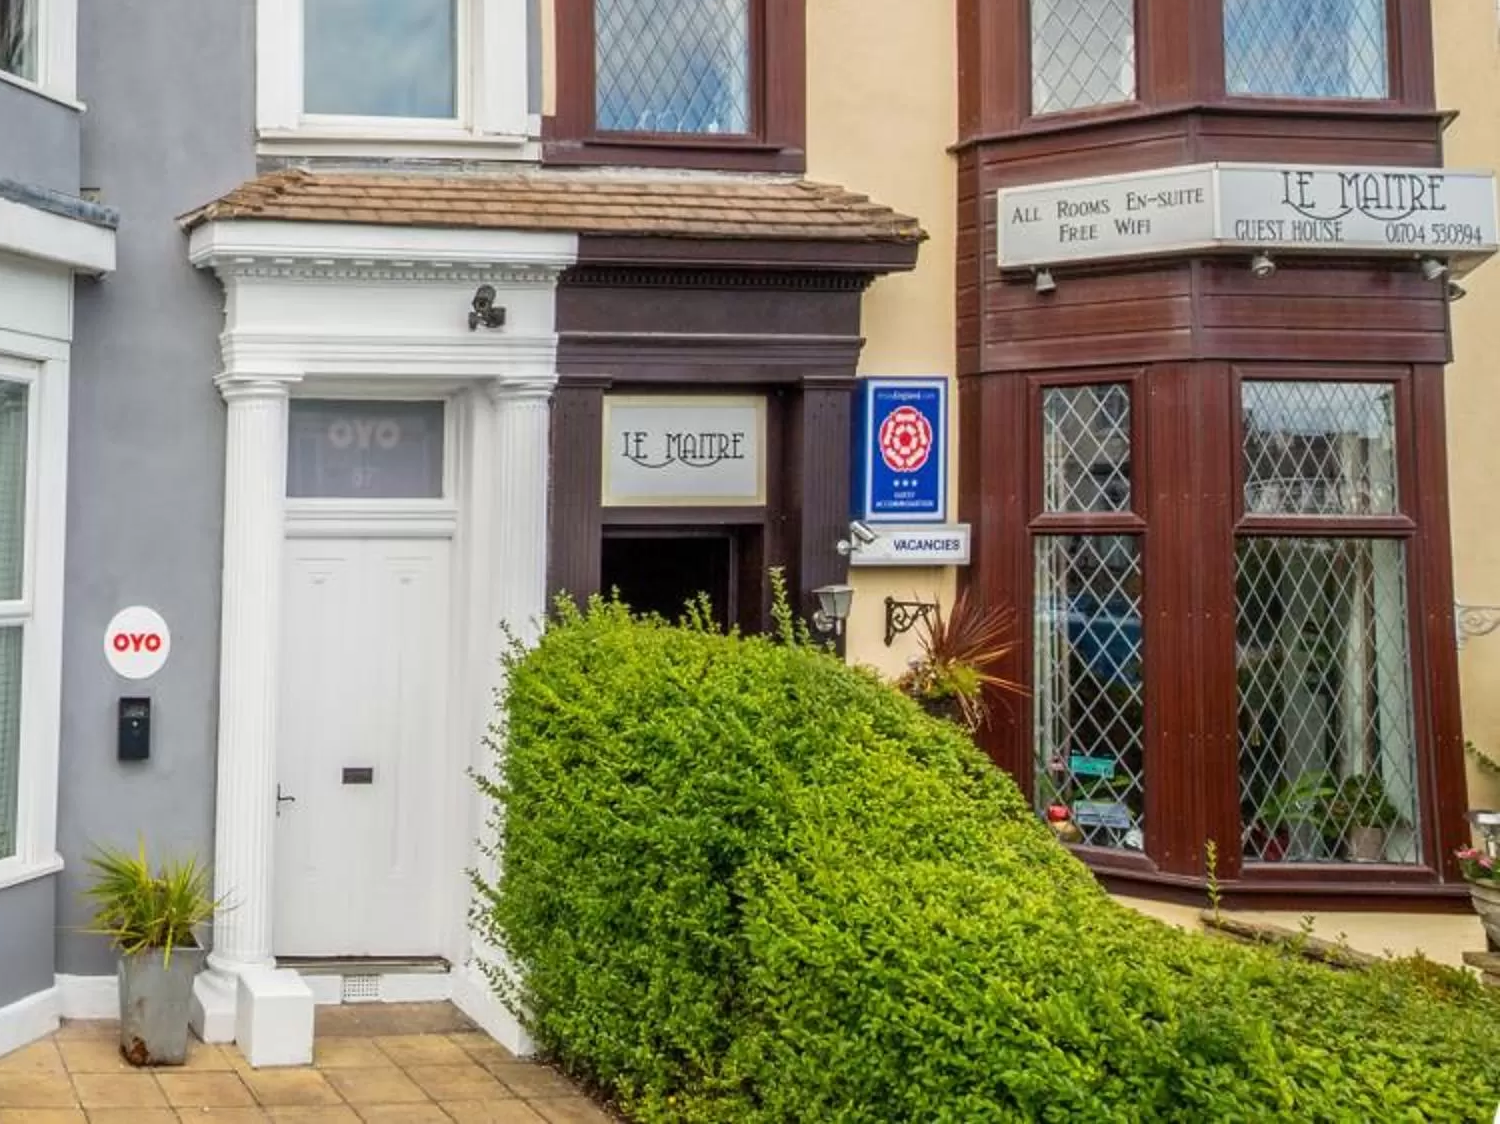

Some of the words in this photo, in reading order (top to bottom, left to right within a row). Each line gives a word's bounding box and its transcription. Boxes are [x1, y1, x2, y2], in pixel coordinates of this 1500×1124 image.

[1281, 170, 1316, 209] LE
[1338, 172, 1447, 211] MAITRE
[1235, 219, 1285, 242] GUEST
[1291, 220, 1345, 243] HOUSE
[327, 418, 400, 450] OYO
[621, 431, 649, 459] LE
[665, 433, 745, 459] MAITRE
[893, 539, 960, 551] VACANCIES
[113, 633, 161, 653] OYO
